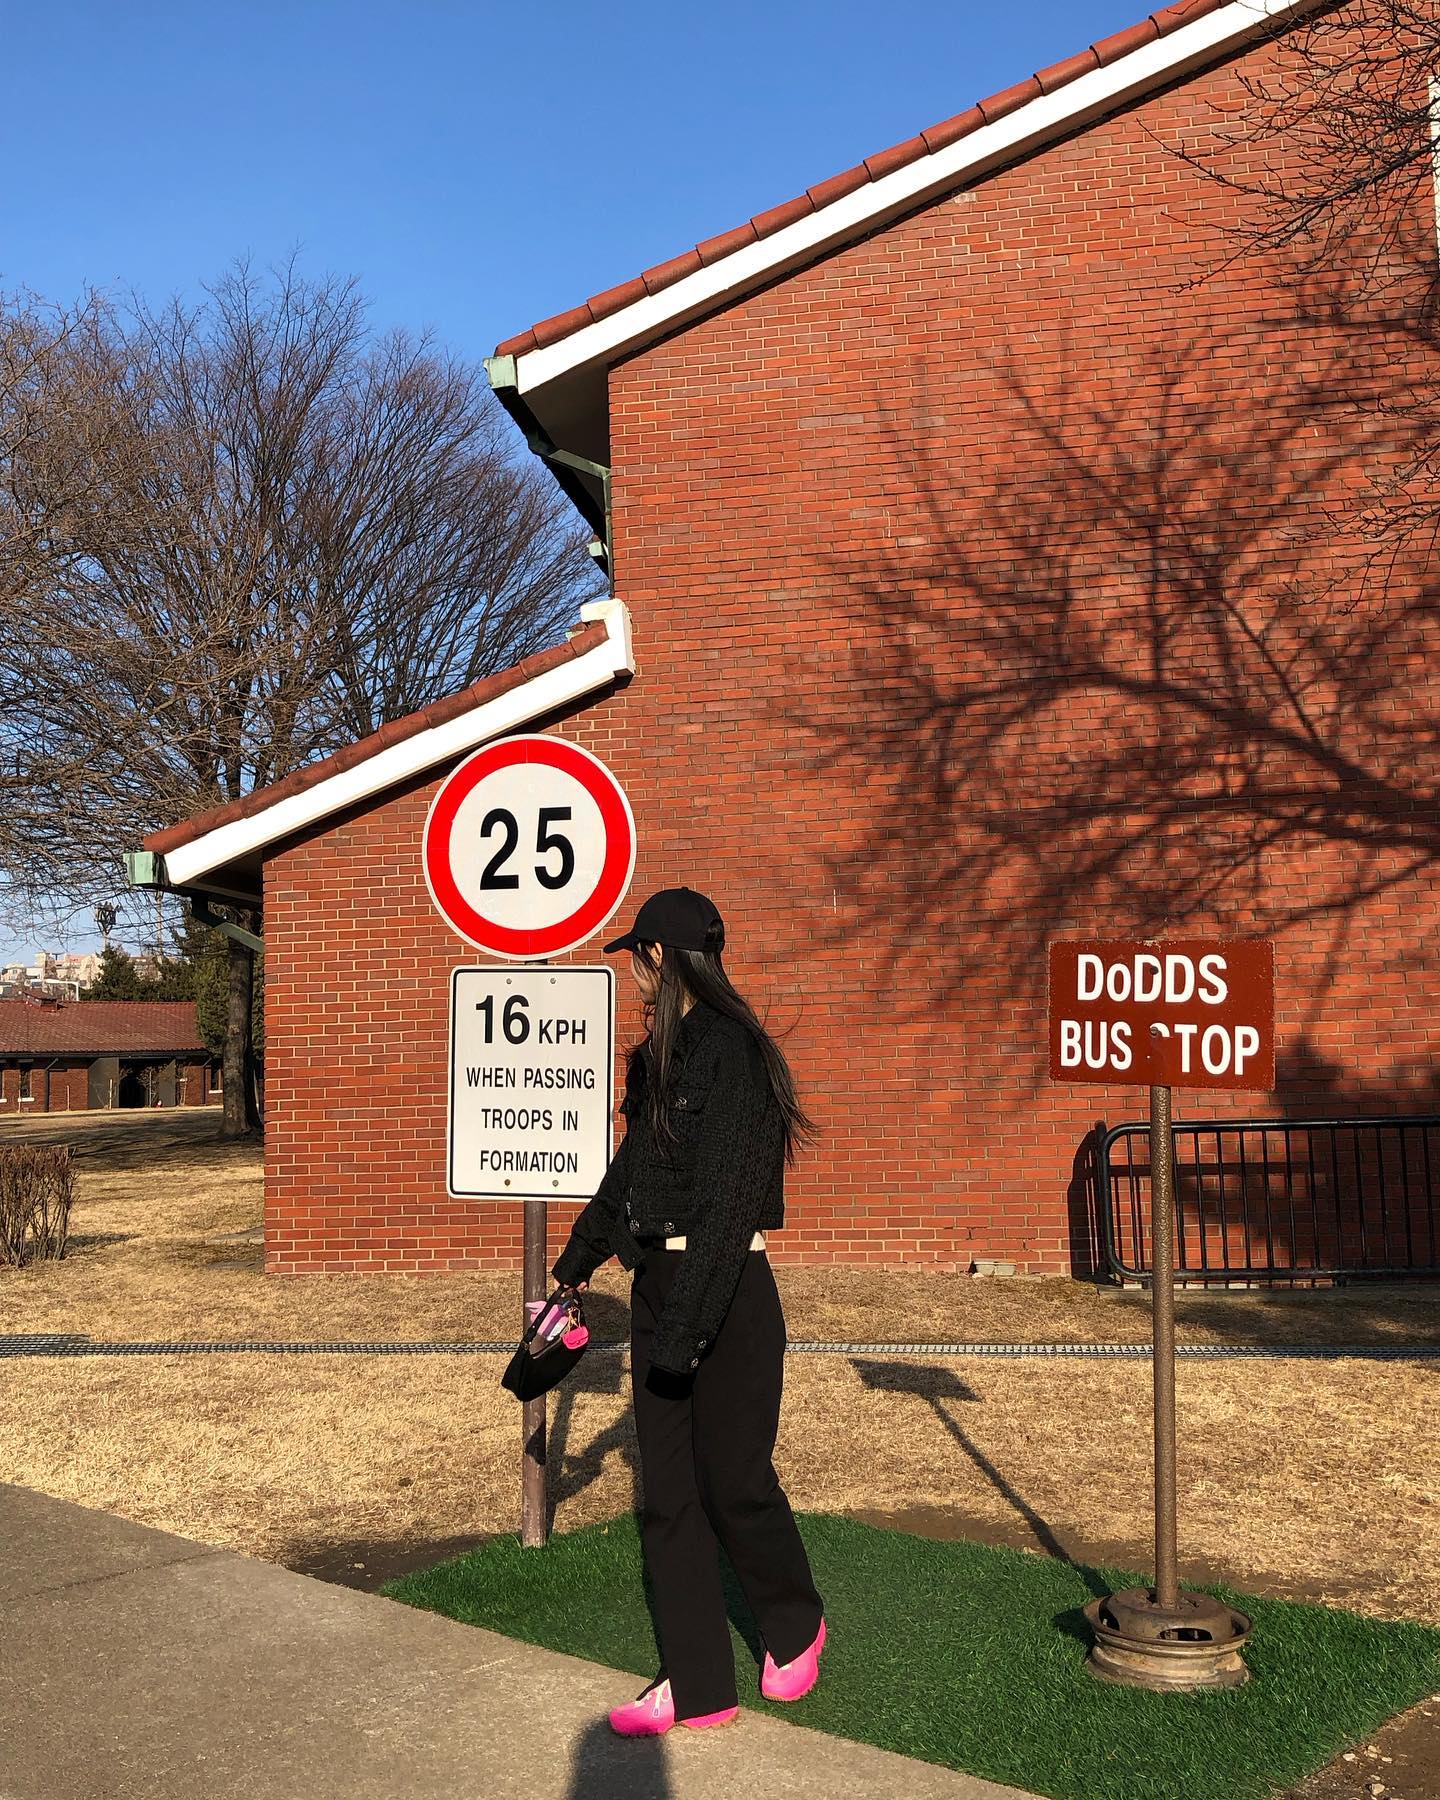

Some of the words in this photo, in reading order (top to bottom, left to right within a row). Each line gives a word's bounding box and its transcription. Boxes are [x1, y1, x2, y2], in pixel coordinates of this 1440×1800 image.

[479, 806, 575, 891] 25
[1077, 953, 1228, 1005] DoDDS
[475, 994, 531, 1045] 16
[538, 1018, 586, 1045] KPH
[1060, 1019, 1133, 1070] BUS
[1149, 1022, 1260, 1076] TOP
[466, 1066, 516, 1088] WHEN
[524, 1067, 595, 1090] PASSING
[481, 1108, 553, 1131] TROOPS
[562, 1109, 578, 1131] IN
[480, 1149, 578, 1173] FORMATION
